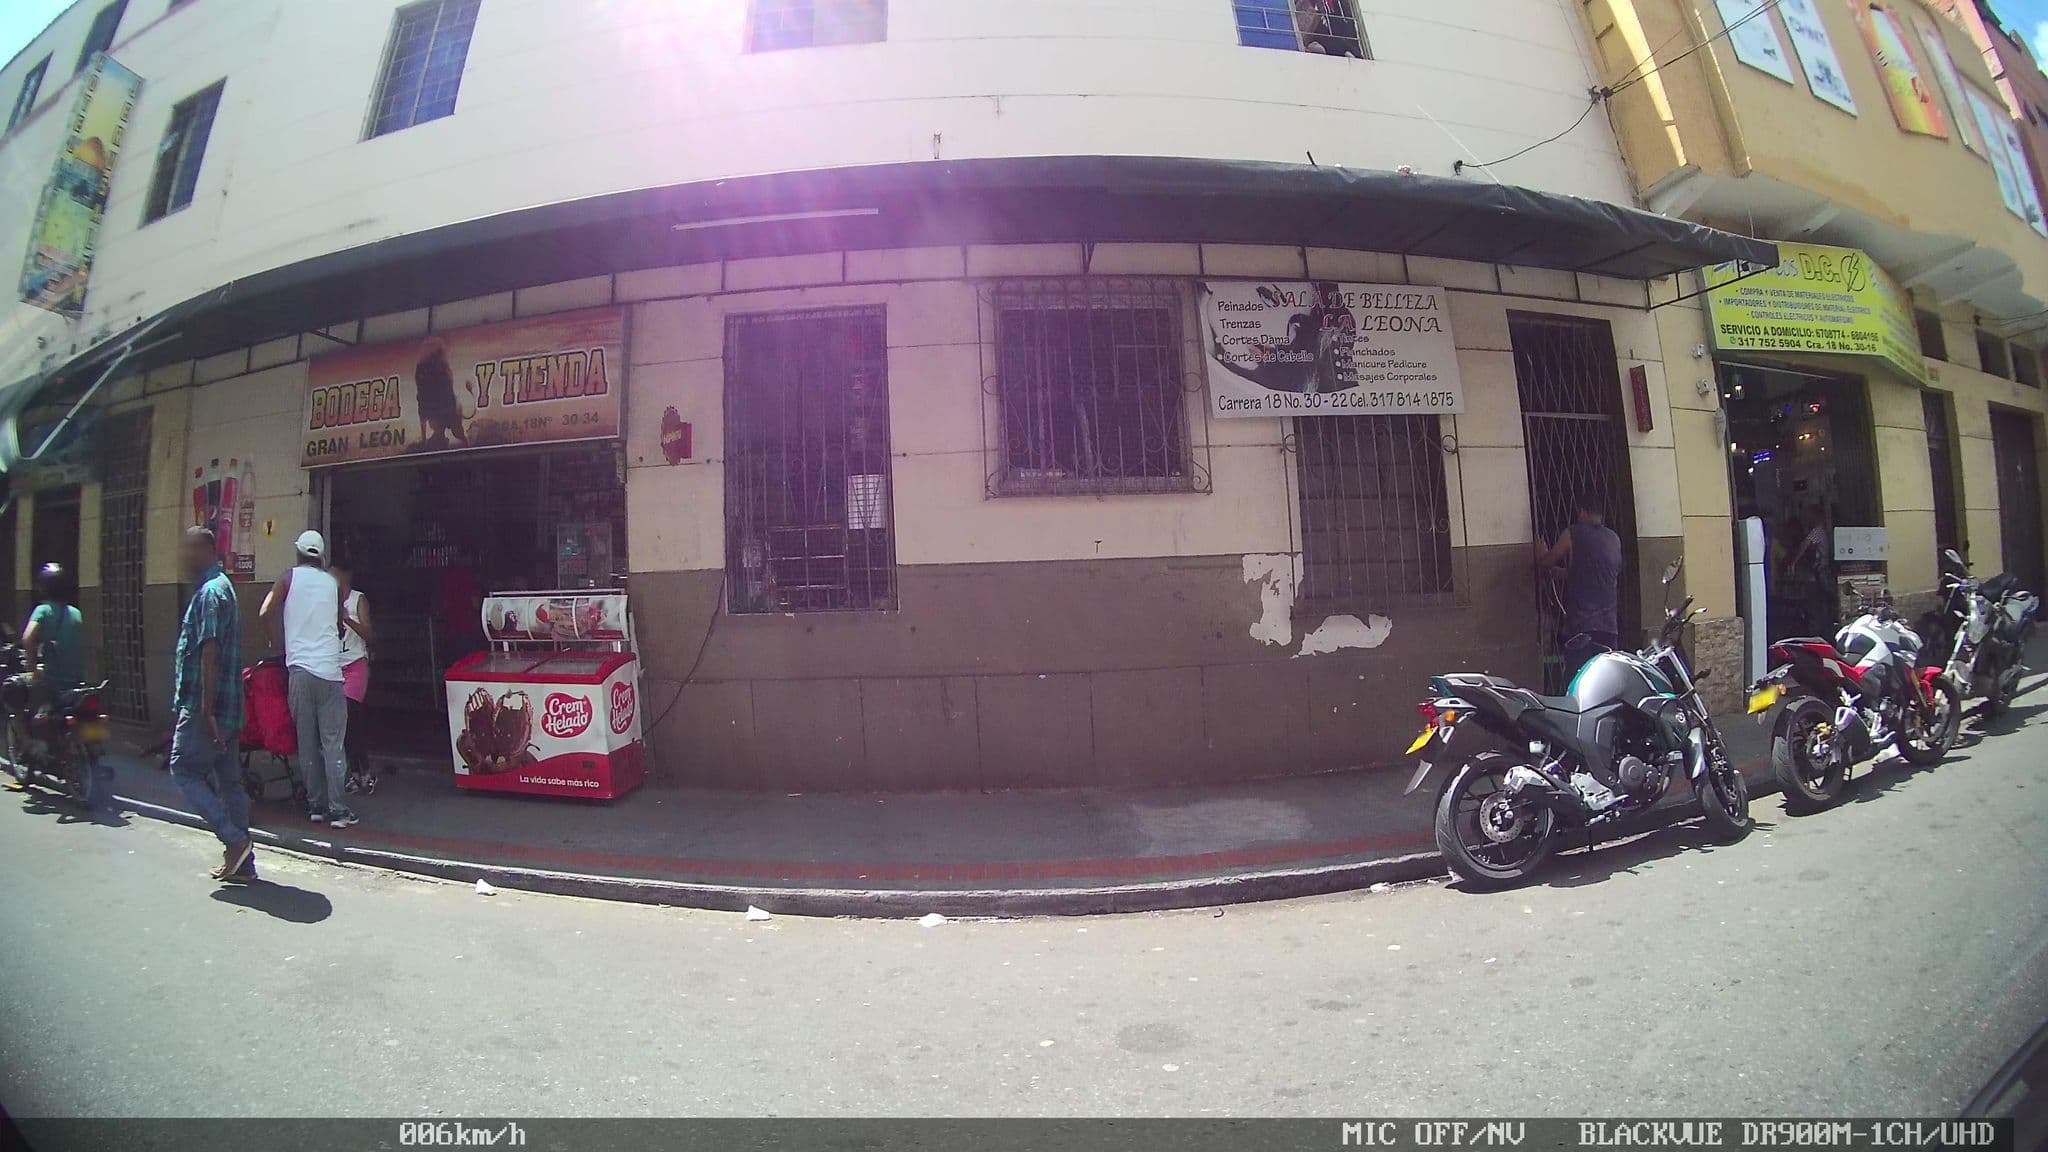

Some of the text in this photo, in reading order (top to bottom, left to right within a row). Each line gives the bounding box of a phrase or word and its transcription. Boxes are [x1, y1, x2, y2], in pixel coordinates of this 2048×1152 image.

[1798, 252, 1842, 283] D.C.
[1739, 287, 1764, 296] COMPRA
[1217, 300, 1264, 312] Peinados
[1271, 290, 1439, 311] SALA DE BELLEZA
[1723, 297, 1767, 307] IMPORTADORES
[1750, 311, 1783, 320] CONTROLES
[1219, 318, 1262, 329] Trenzas
[1322, 314, 1443, 333] LA LEONA
[1720, 324, 1761, 335] SERVICIO
[1763, 326, 1770, 336] A
[1771, 326, 1815, 338] DOMICILIO:
[1222, 334, 1290, 345] Cortes Dama
[1737, 337, 1755, 346] 317
[1758, 338, 1777, 347] 752
[1779, 339, 1802, 348] 5904
[1806, 340, 1825, 349] Cra.
[1826, 341, 1837, 350] 18
[1839, 341, 1854, 351] No.
[1224, 351, 1261, 363] Cortes
[1264, 351, 1277, 362] de
[1341, 359, 1427, 369] Manicure Pedicure
[1342, 372, 1438, 385] Masajes Corporales
[310, 347, 609, 430] BODEGA Y TIENDA
[1218, 394, 1262, 411] Carrera
[1264, 392, 1282, 409] 18
[1284, 393, 1303, 409] No.
[1303, 393, 1322, 409] 30
[1331, 393, 1349, 408] 22
[1349, 393, 1369, 408] Cel.
[1371, 392, 1394, 408] 317
[1396, 392, 1421, 407] 814
[1423, 391, 1454, 407] 1875
[306, 424, 406, 458] GRAN LEÓN
[548, 697, 585, 716] Crem
[545, 711, 589, 735] Helado
[519, 774, 530, 784] La
[530, 775, 547, 785] vida
[547, 777, 566, 787] sabe
[584, 779, 600, 788] rico
